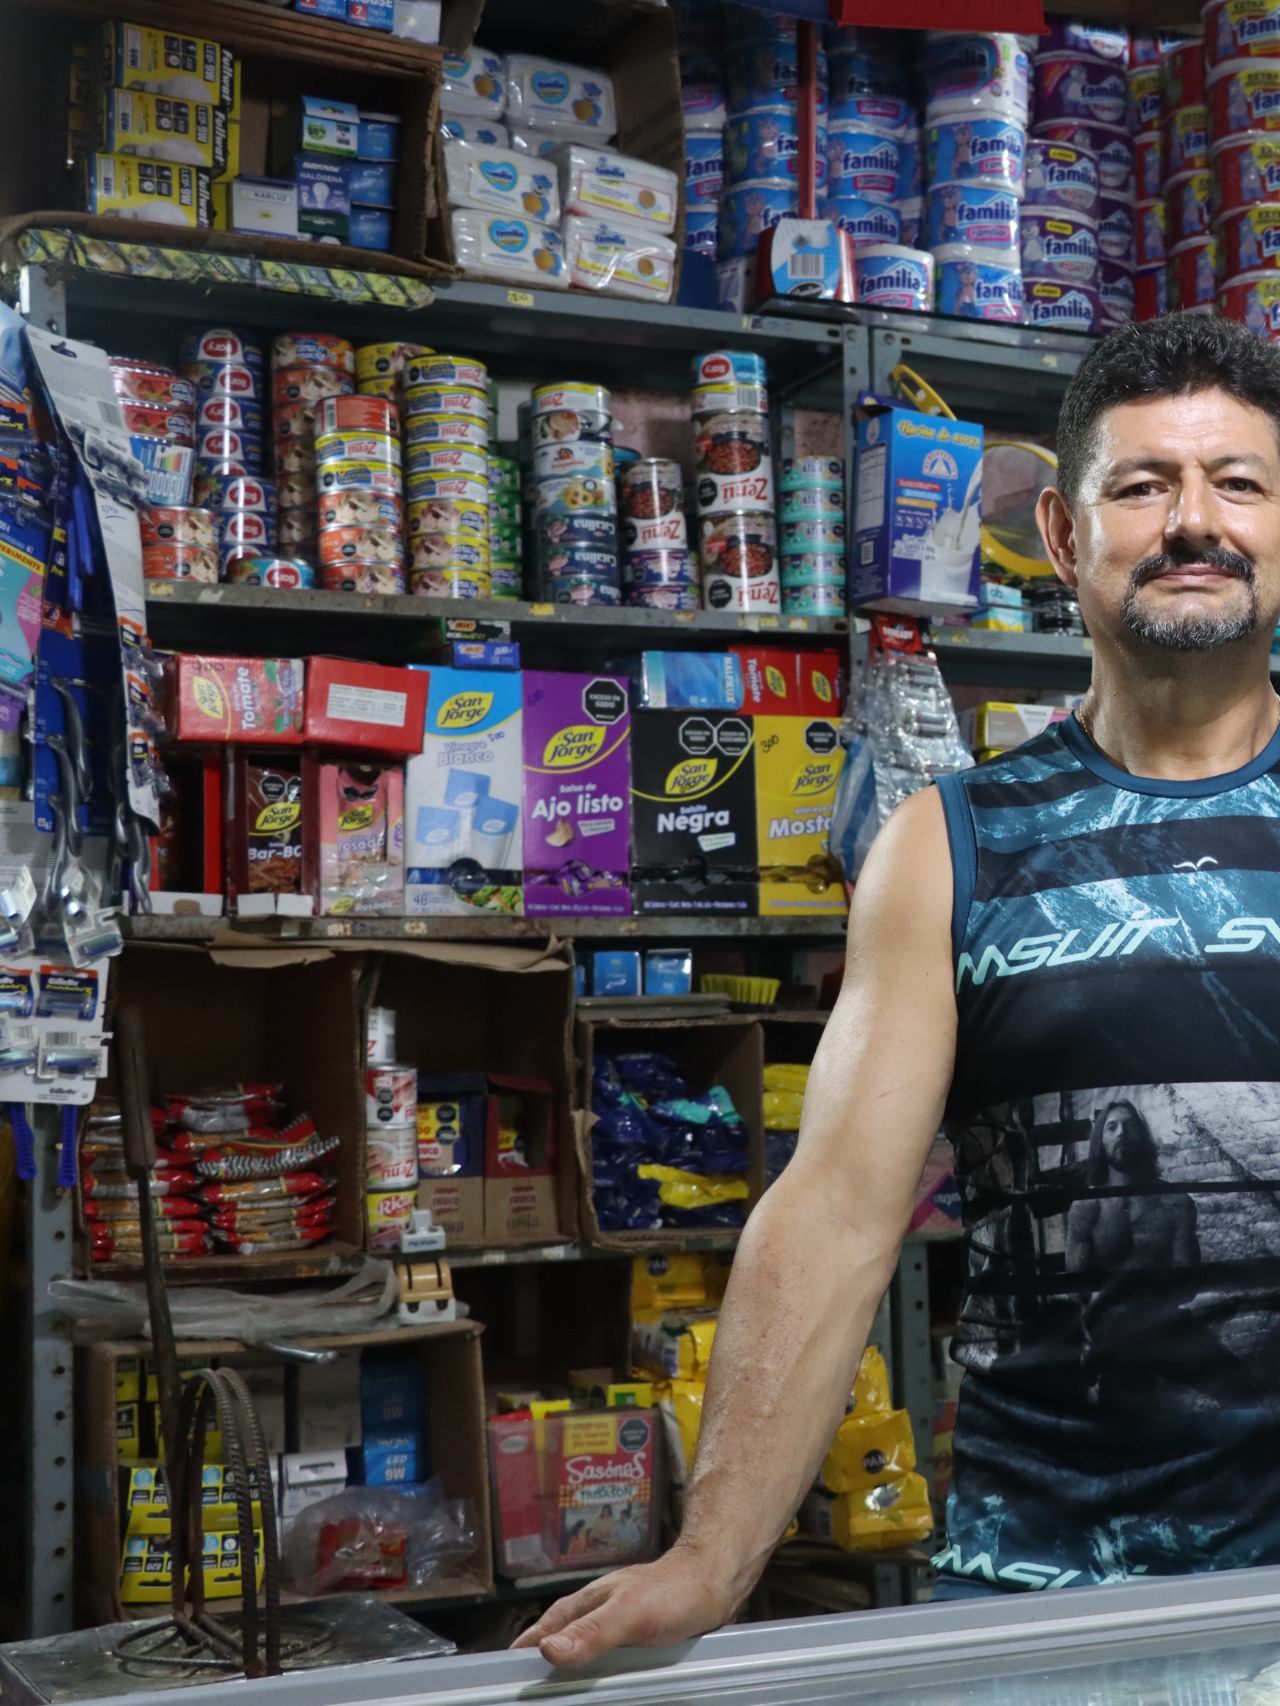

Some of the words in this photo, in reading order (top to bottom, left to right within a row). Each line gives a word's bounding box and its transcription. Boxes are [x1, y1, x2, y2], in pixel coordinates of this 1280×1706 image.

[837, 213, 899, 237] familia
[861, 268, 921, 294] familia
[1032, 297, 1092, 321] familia
[897, 420, 936, 440] Harina
[938, 427, 951, 442] de
[454, 621, 475, 630] BIC
[747, 658, 762, 704] Tomate
[237, 666, 257, 731] Tomate
[452, 696, 483, 709] San
[441, 707, 486, 726] Jorge
[443, 740, 488, 752] Vinagre
[561, 731, 594, 746] San
[760, 734, 780, 755] 300
[437, 750, 495, 767] Blanco
[546, 743, 597, 763] Jorge
[680, 762, 708, 776] San
[804, 763, 831, 776] San
[559, 784, 585, 794] Salsa
[585, 783, 597, 792] de
[670, 773, 711, 791] Jorge
[793, 772, 834, 792] Jorge
[270, 806, 293, 815] San
[531, 798, 572, 822] Ajo
[576, 793, 624, 816] listo
[260, 813, 294, 828] Jorge
[340, 815, 372, 828] Jorge
[657, 809, 731, 834] Negra
[412, 893, 428, 906] 48
[48, 977, 81, 988] Gillette
[646, 1259, 669, 1271] PAN
[385, 1454, 408, 1465] LED
[863, 1455, 887, 1468] PAN
[384, 1466, 406, 1482] 9W
